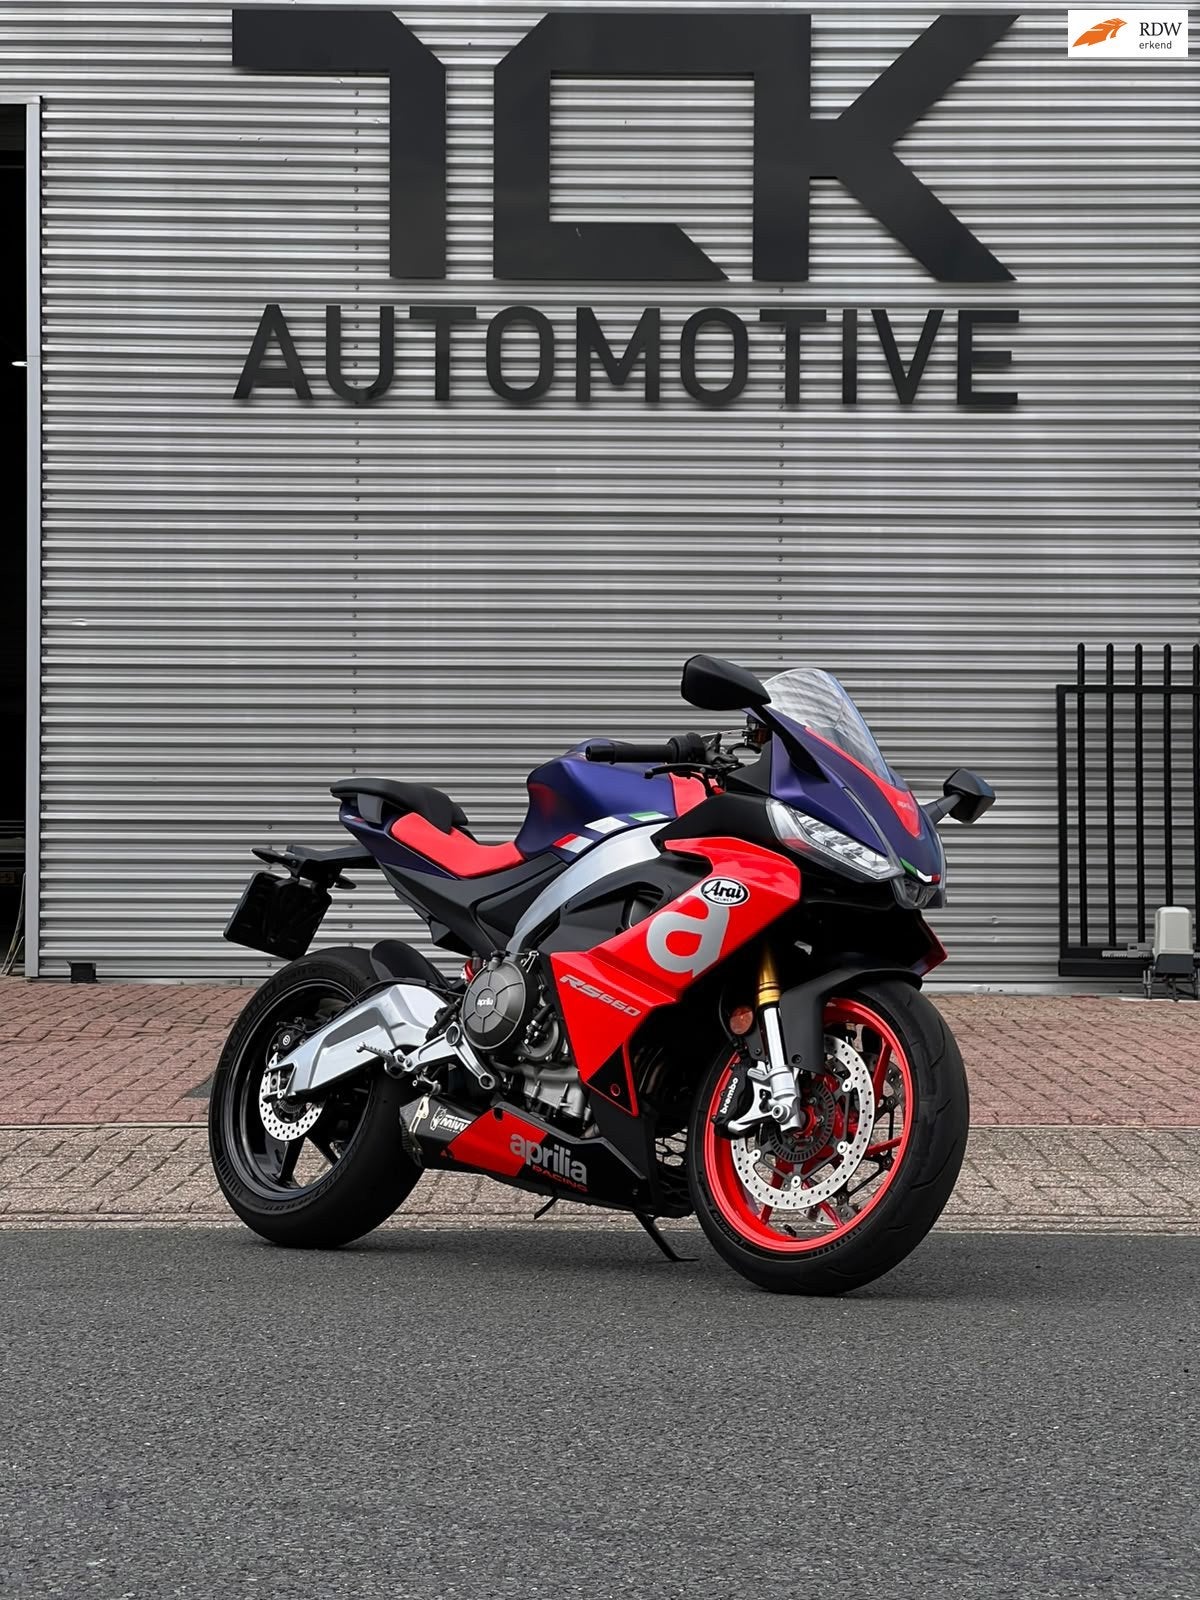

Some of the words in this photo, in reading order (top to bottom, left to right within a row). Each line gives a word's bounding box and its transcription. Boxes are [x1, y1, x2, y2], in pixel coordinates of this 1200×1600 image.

[233, 303, 1019, 407] AUTOMOTIVE
[704, 881, 742, 899] Arai
[720, 1077, 738, 1114] brembo
[509, 1133, 588, 1185] aprilia
[532, 1164, 590, 1194] RACING
